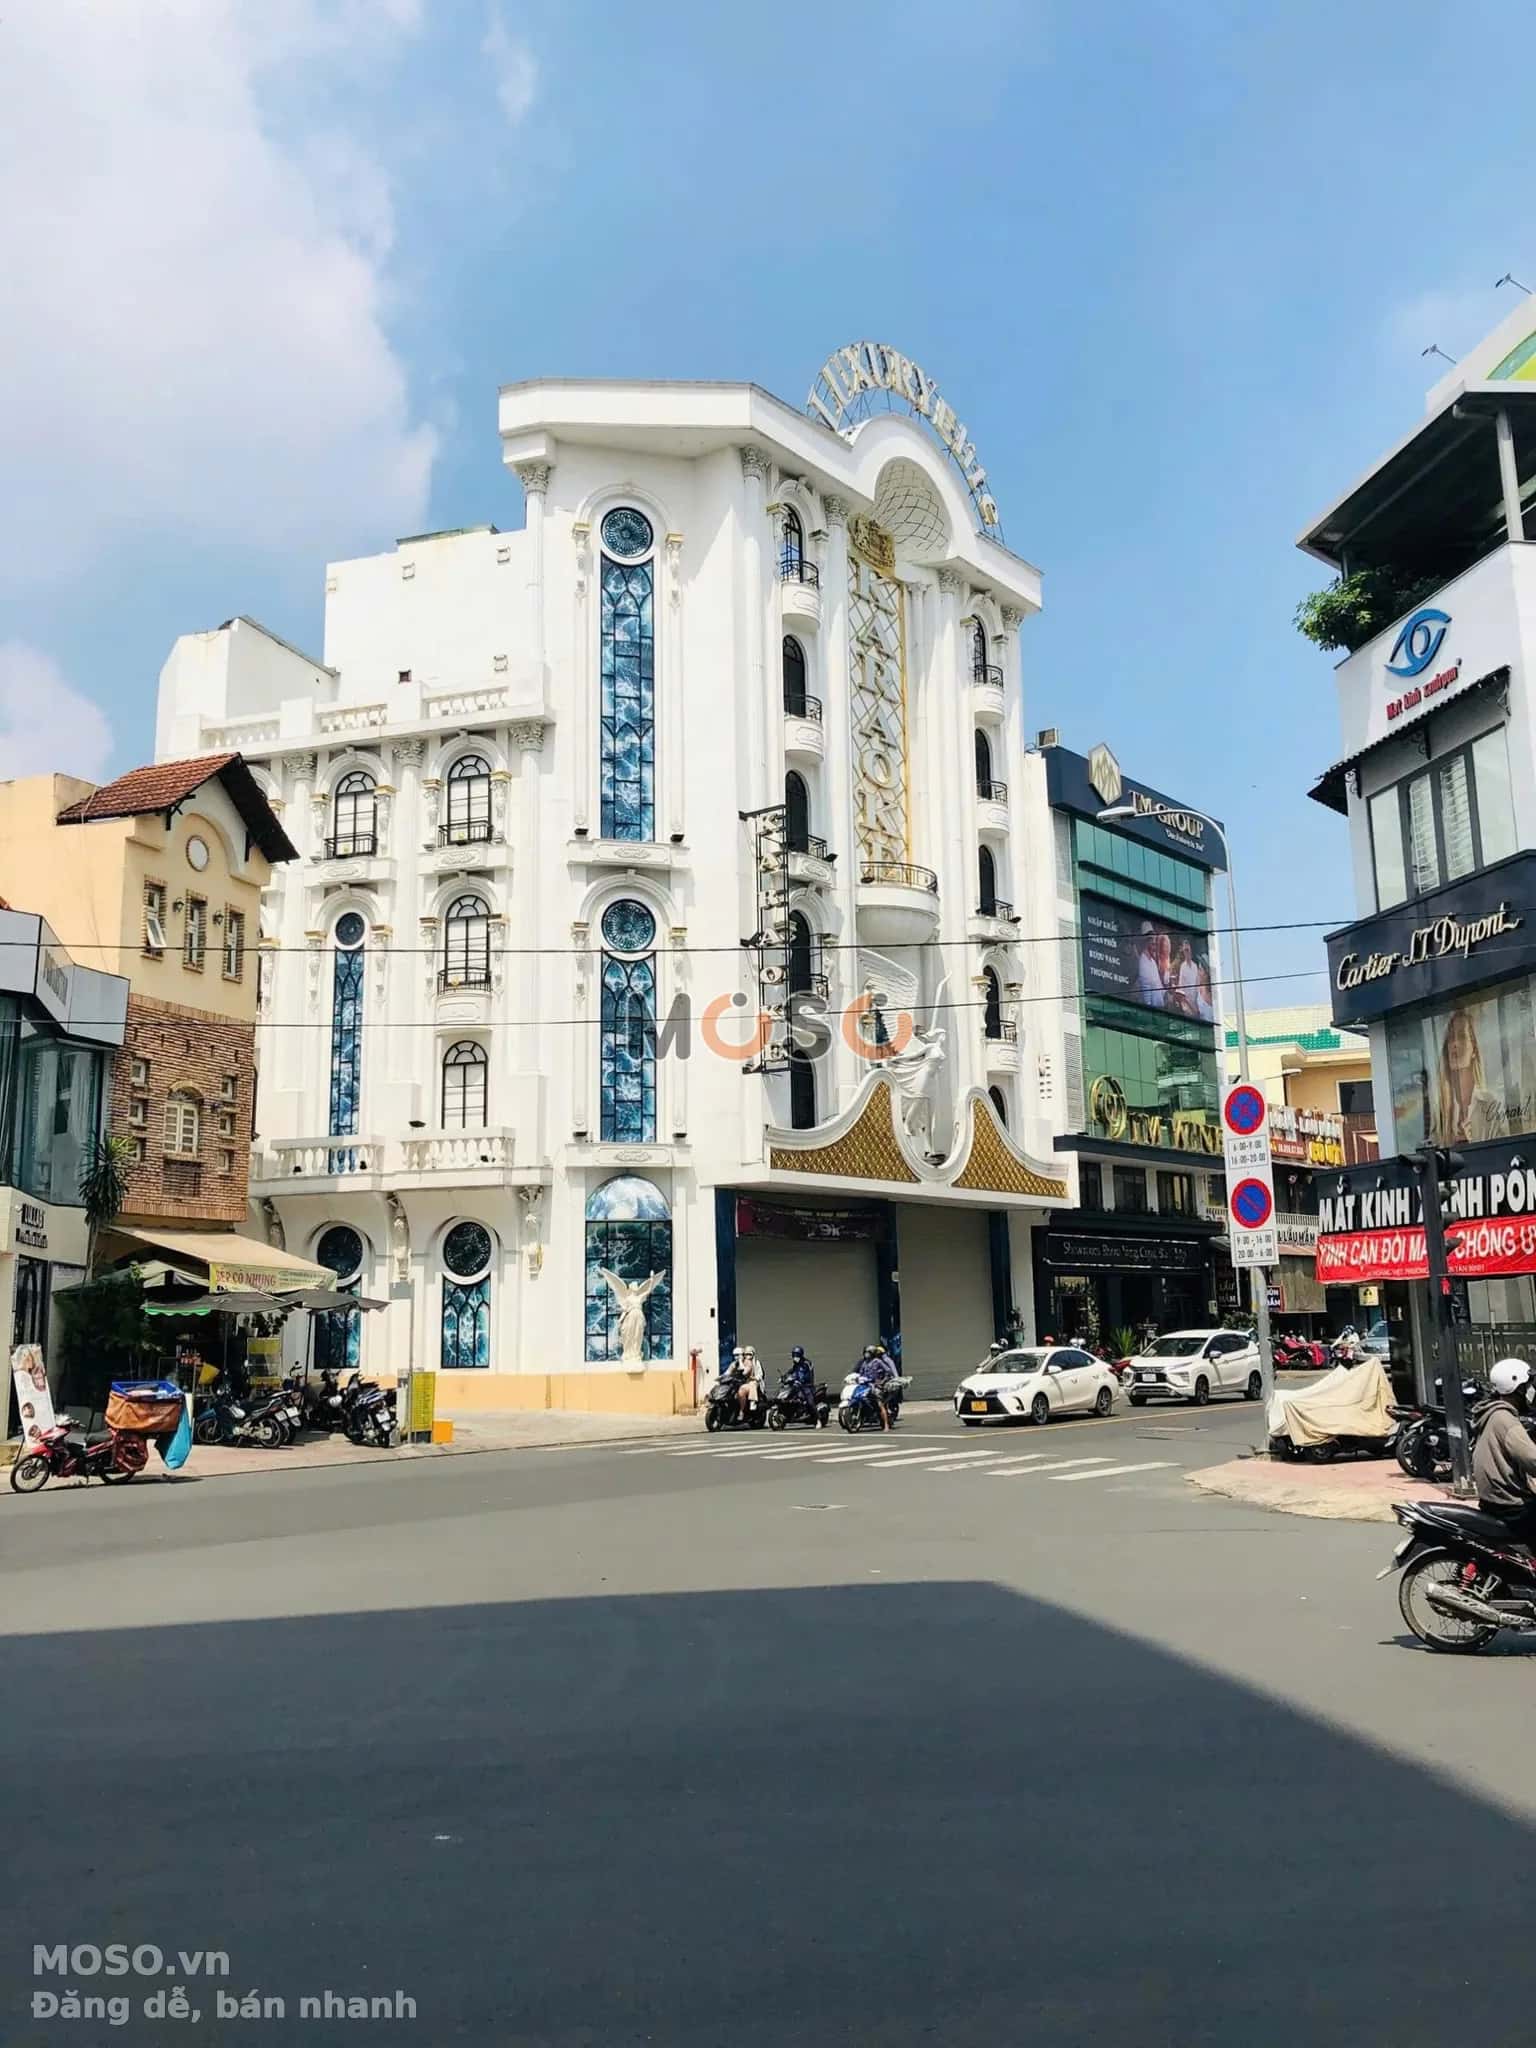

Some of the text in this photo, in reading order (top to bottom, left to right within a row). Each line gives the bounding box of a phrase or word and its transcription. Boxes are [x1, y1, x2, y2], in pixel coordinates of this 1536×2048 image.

[856, 558, 900, 878] KARAOKE
[1154, 803, 1203, 838] GROUP
[1336, 951, 1401, 991] Cartier
[1433, 901, 1523, 959] Dupont
[1318, 1175, 1356, 1232] MẮT
[1361, 1176, 1410, 1229] KÍNH
